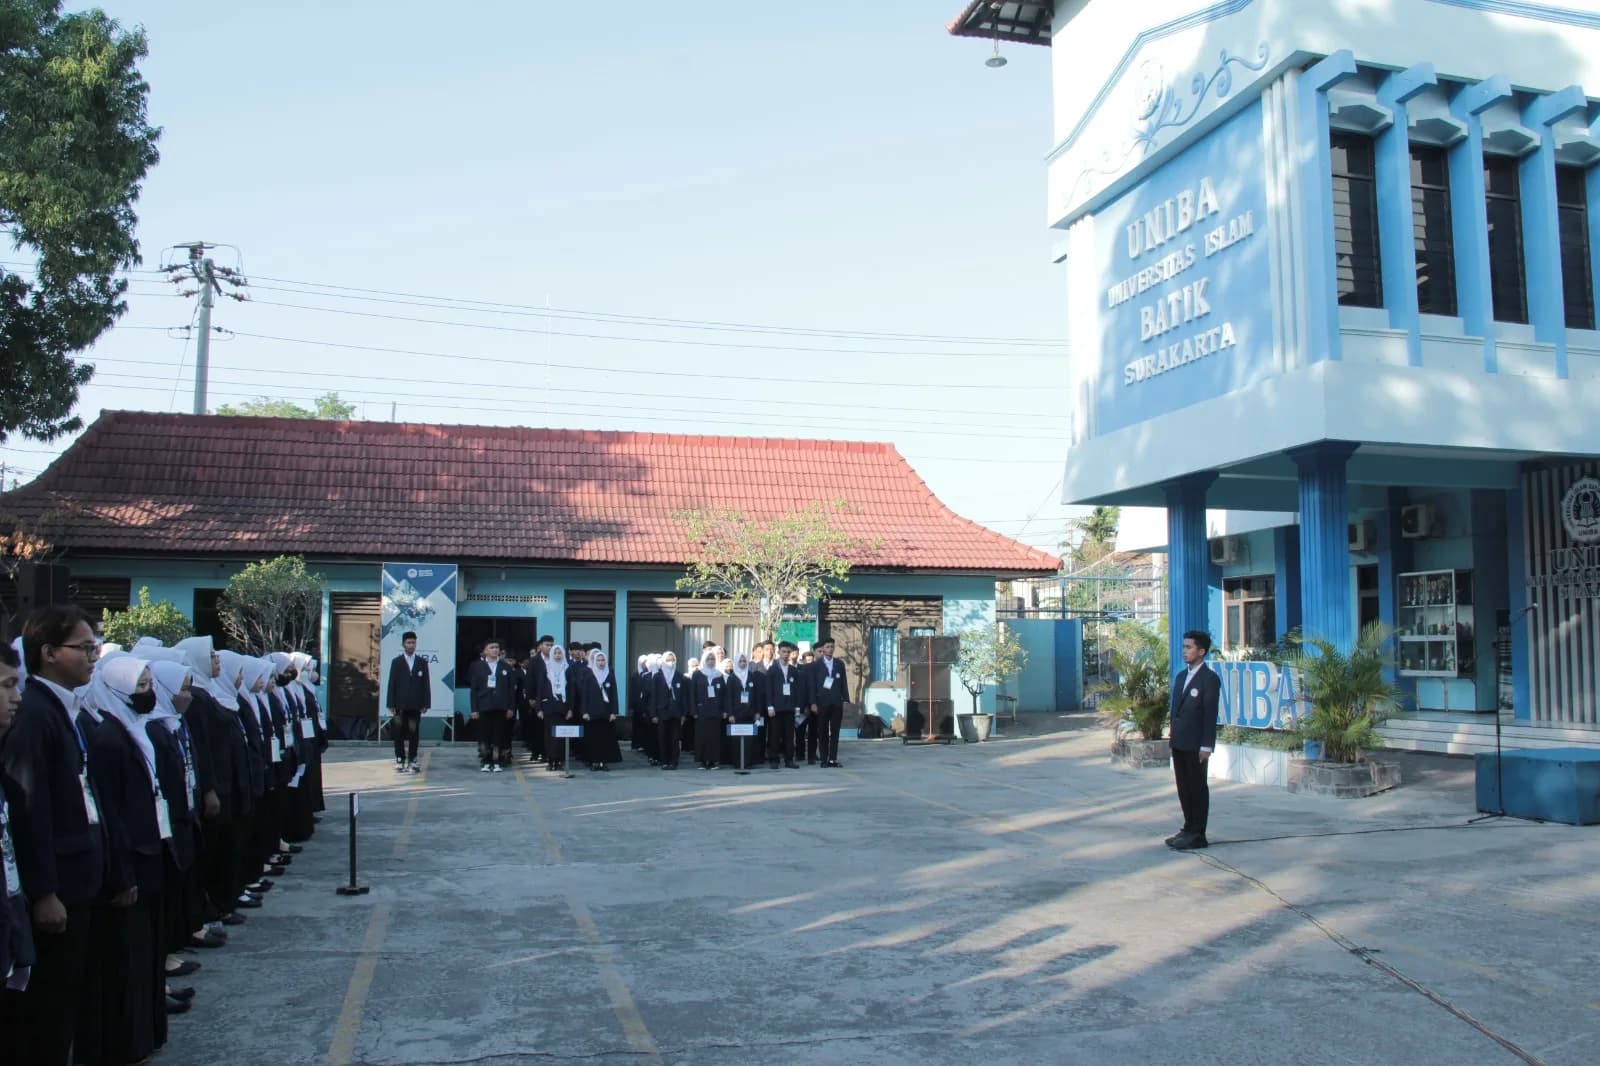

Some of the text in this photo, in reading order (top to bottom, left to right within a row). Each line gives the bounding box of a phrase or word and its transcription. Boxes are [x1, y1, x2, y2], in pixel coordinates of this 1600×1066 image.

[1127, 176, 1219, 260] UNIBA
[1108, 210, 1254, 308] UNIVERSITAS ISLAM
[1140, 277, 1211, 342] BATIK
[1124, 322, 1237, 386] SURAKARTA
[1206, 661, 1300, 730] NIBA
